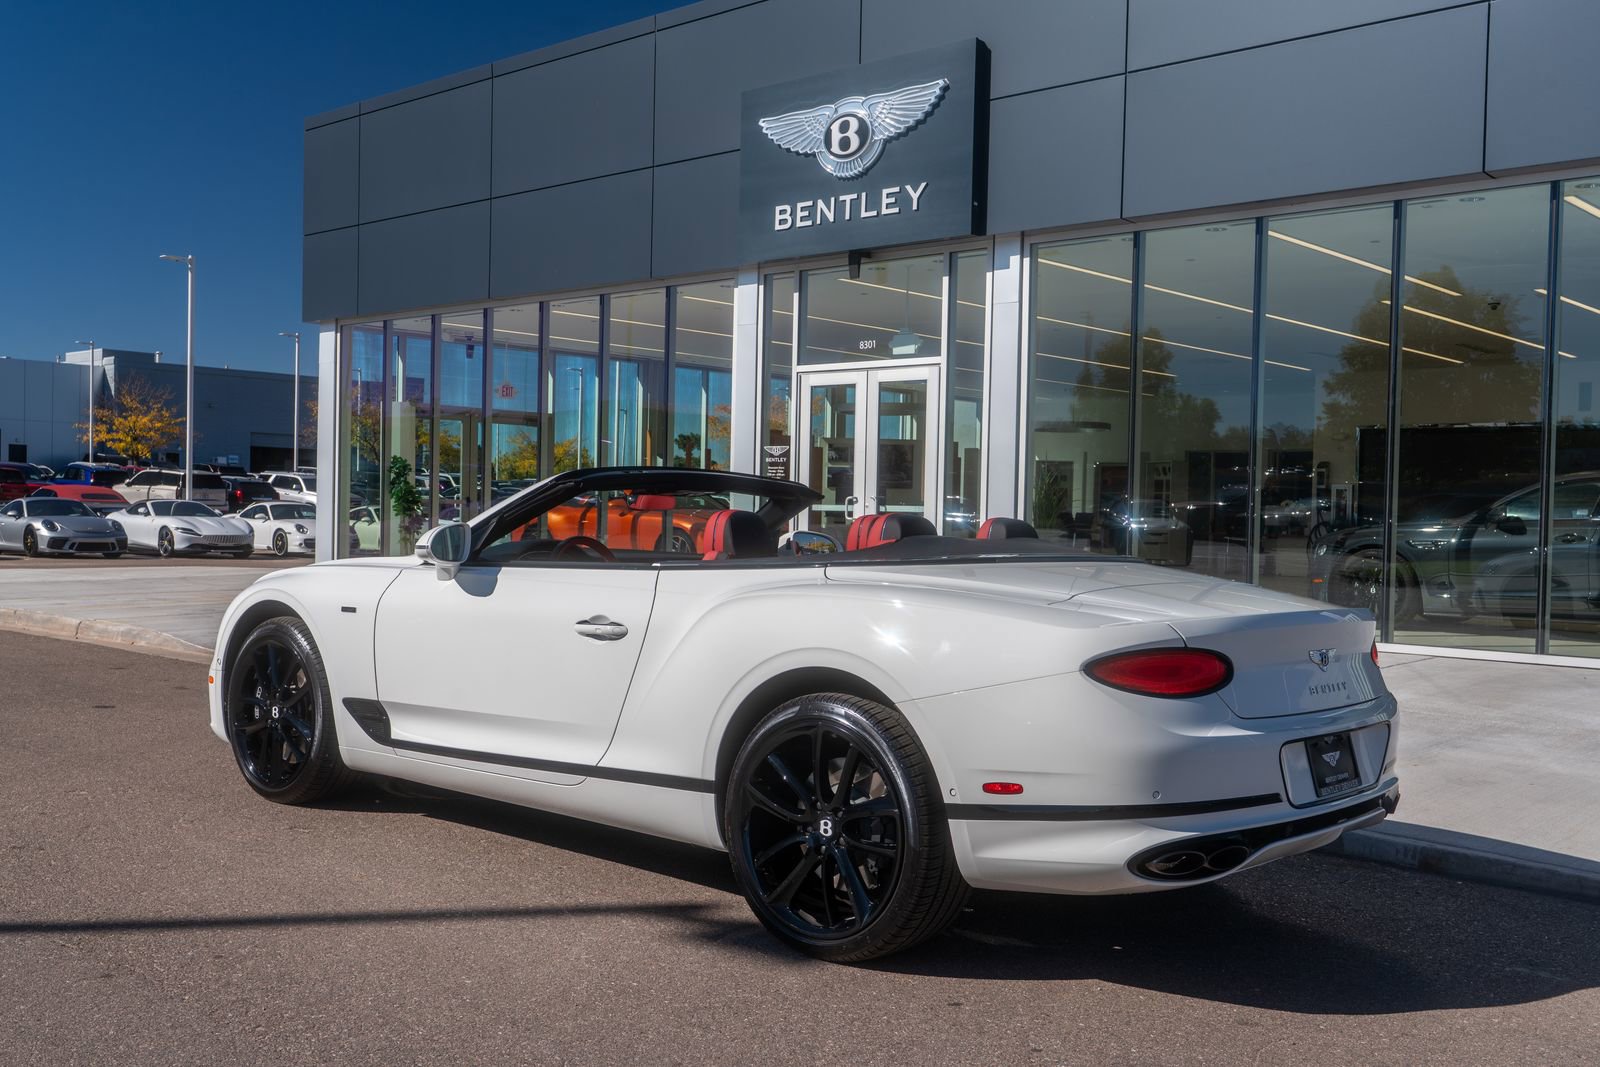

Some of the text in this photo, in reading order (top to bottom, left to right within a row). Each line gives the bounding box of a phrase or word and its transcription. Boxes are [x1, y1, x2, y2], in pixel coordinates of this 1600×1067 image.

[775, 182, 928, 231] BENTLEY
[860, 340, 876, 349] 8301
[501, 385, 513, 397] EXIT
[820, 820, 833, 836] B
